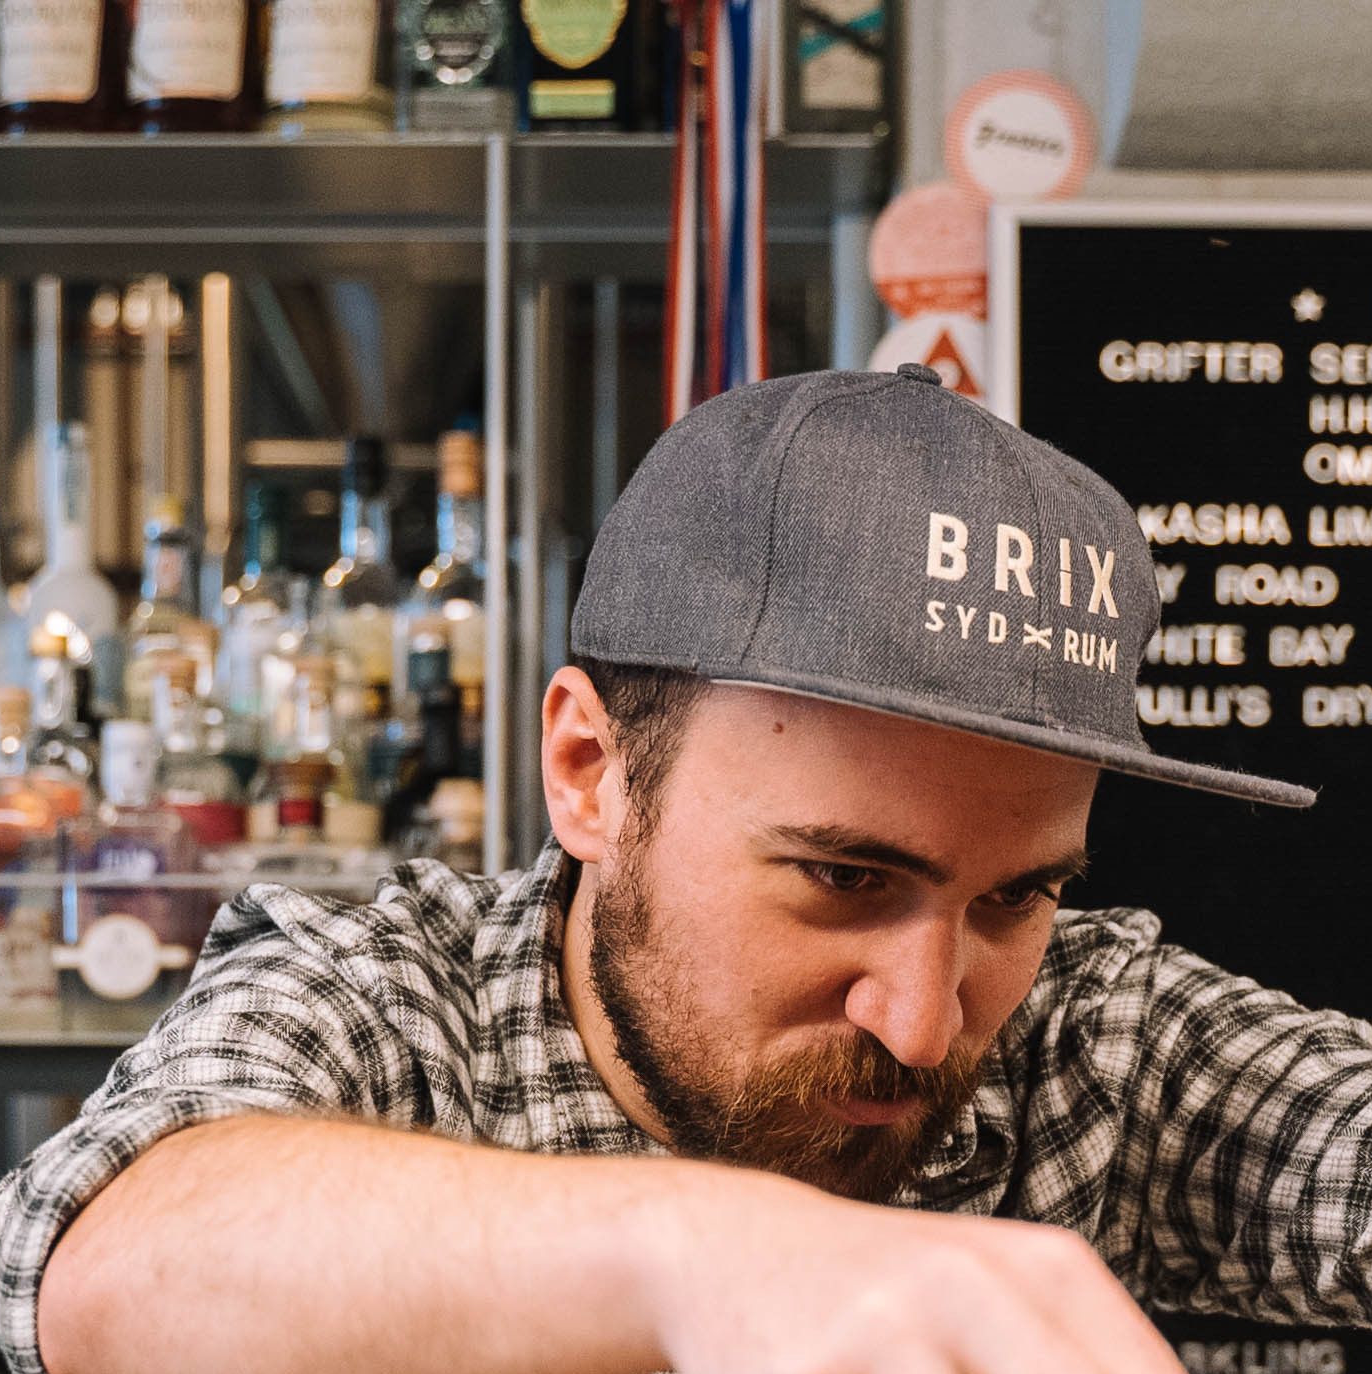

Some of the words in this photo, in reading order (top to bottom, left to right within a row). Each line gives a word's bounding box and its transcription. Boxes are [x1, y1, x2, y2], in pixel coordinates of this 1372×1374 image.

[1099, 340, 1284, 384] GRIFTER
[926, 512, 1120, 619] BRIX
[1215, 562, 1340, 607] ROAD
[924, 600, 1008, 644] SYD
[1063, 627, 1119, 674] RUM
[1145, 623, 1248, 666] HITE
[1268, 623, 1356, 667] BAY
[1135, 684, 1272, 728] ULLI'S
